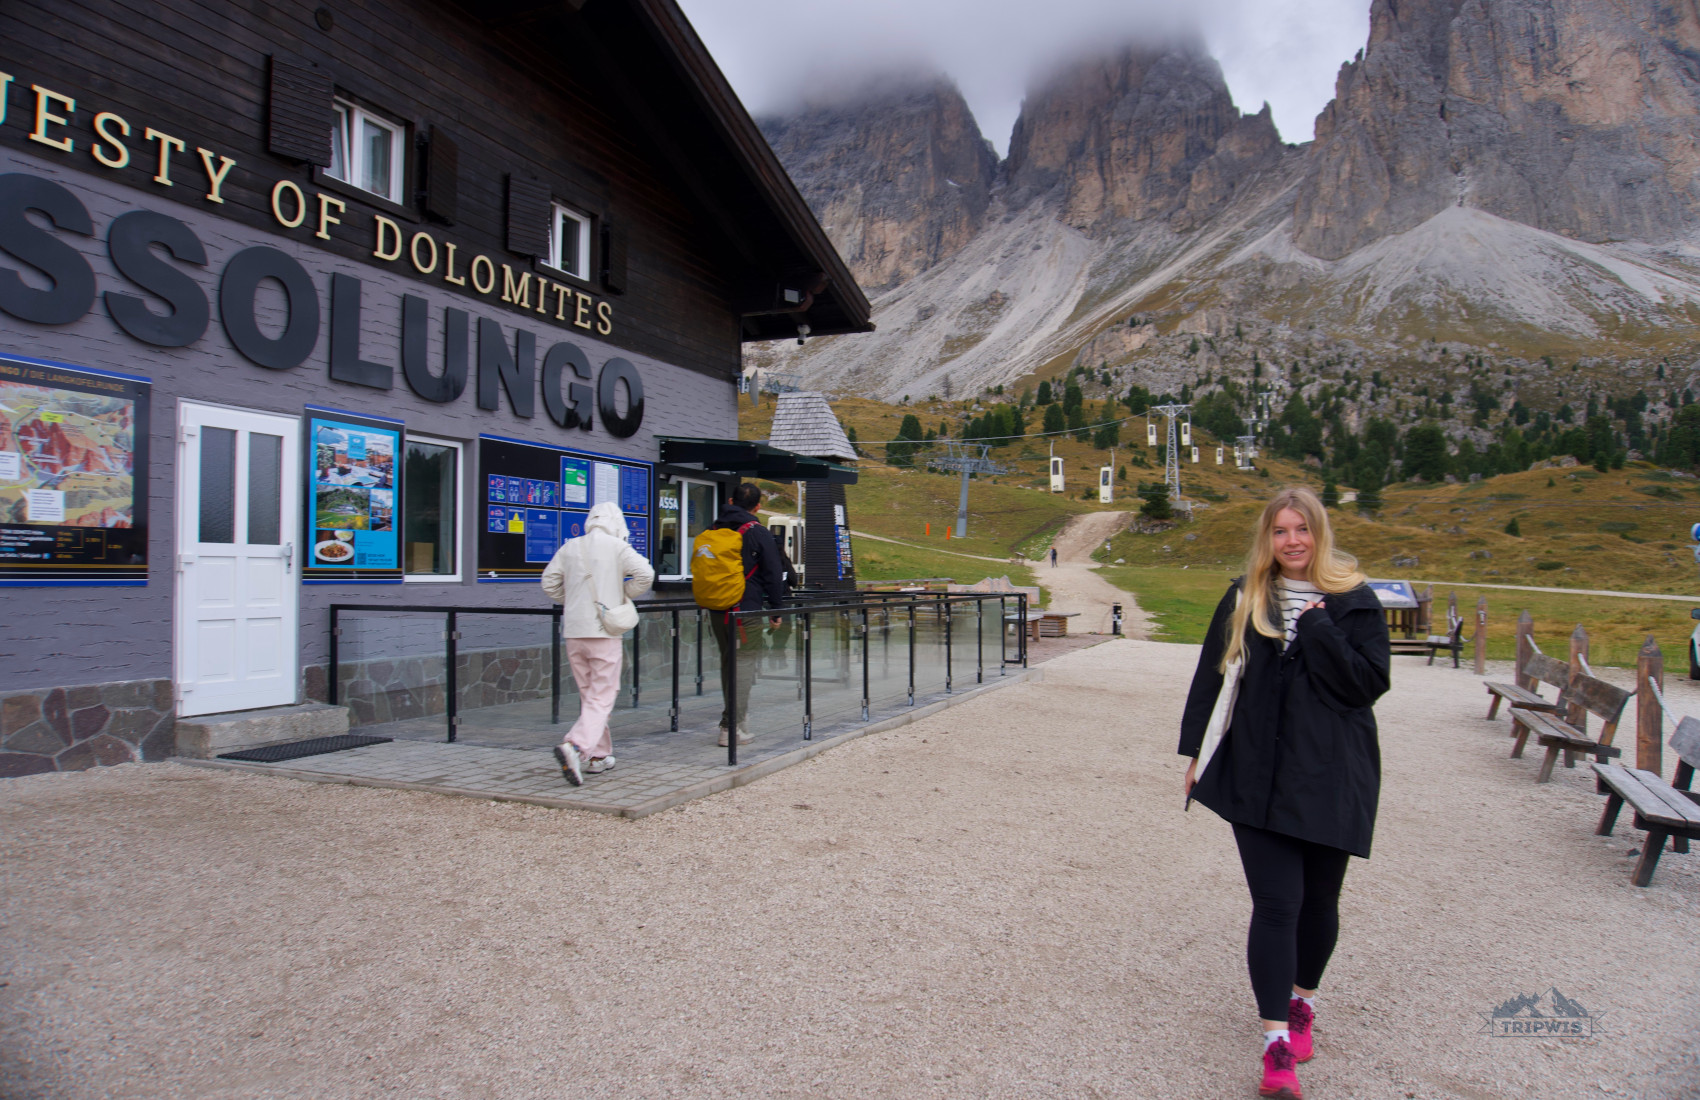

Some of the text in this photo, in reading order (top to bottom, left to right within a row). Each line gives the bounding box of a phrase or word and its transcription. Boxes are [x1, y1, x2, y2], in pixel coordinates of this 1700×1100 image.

[0, 172, 645, 439] SSOLUNGO
[271, 179, 346, 240] OF
[372, 214, 613, 336] DOLOMITES
